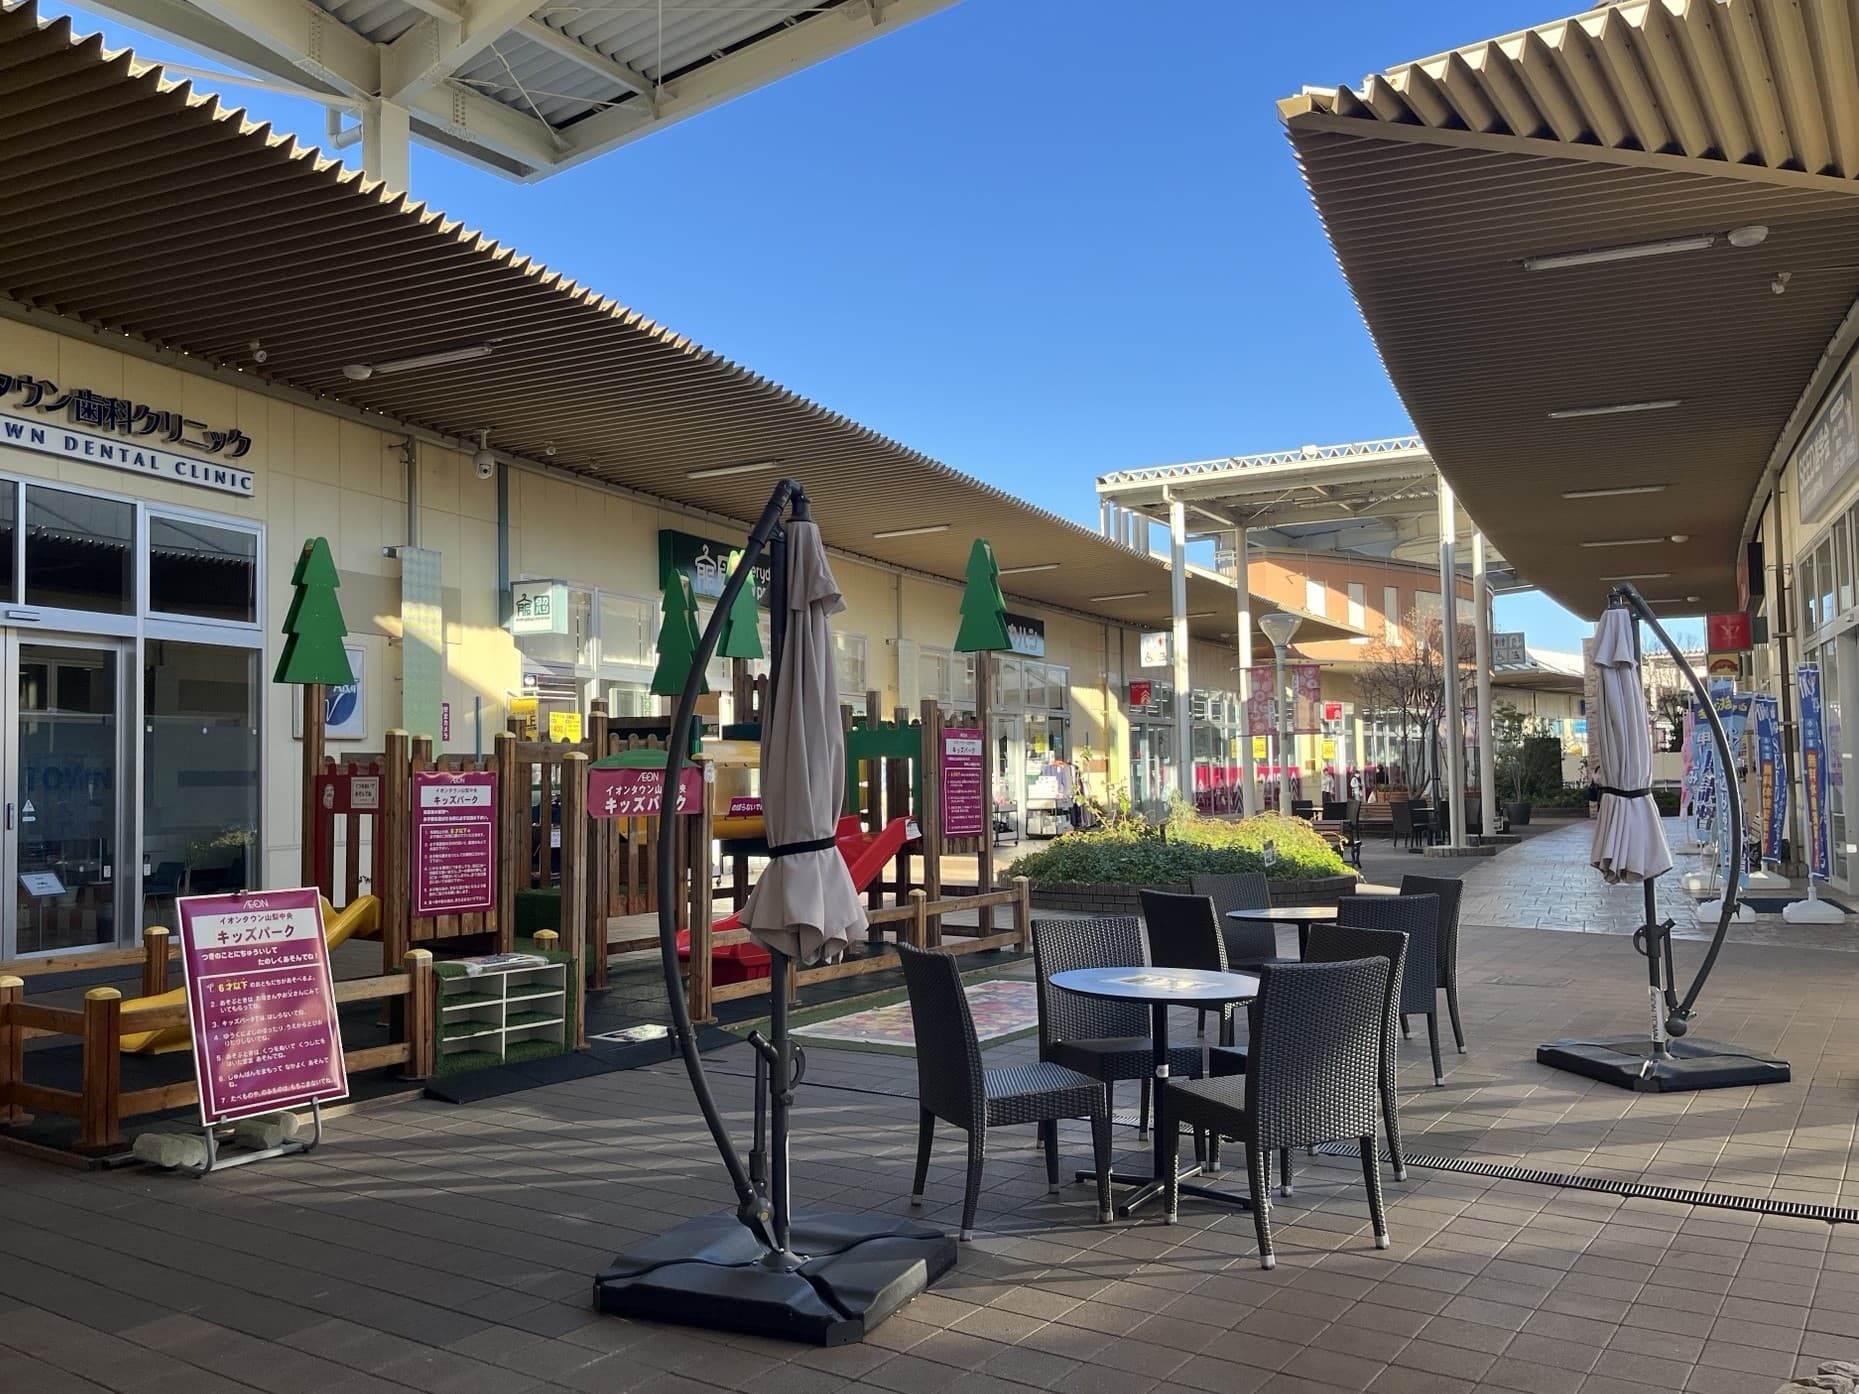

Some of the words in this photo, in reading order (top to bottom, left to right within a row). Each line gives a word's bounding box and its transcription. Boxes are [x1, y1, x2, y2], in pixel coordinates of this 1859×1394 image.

[64, 435, 160, 469] DENTAL
[175, 461, 252, 490] CLINIC
[434, 795, 478, 805] キッズパーク
[606, 784, 687, 796] イオンタウン山央
[605, 795, 686, 815] キッズパク
[217, 924, 295, 945] キッズパーク
